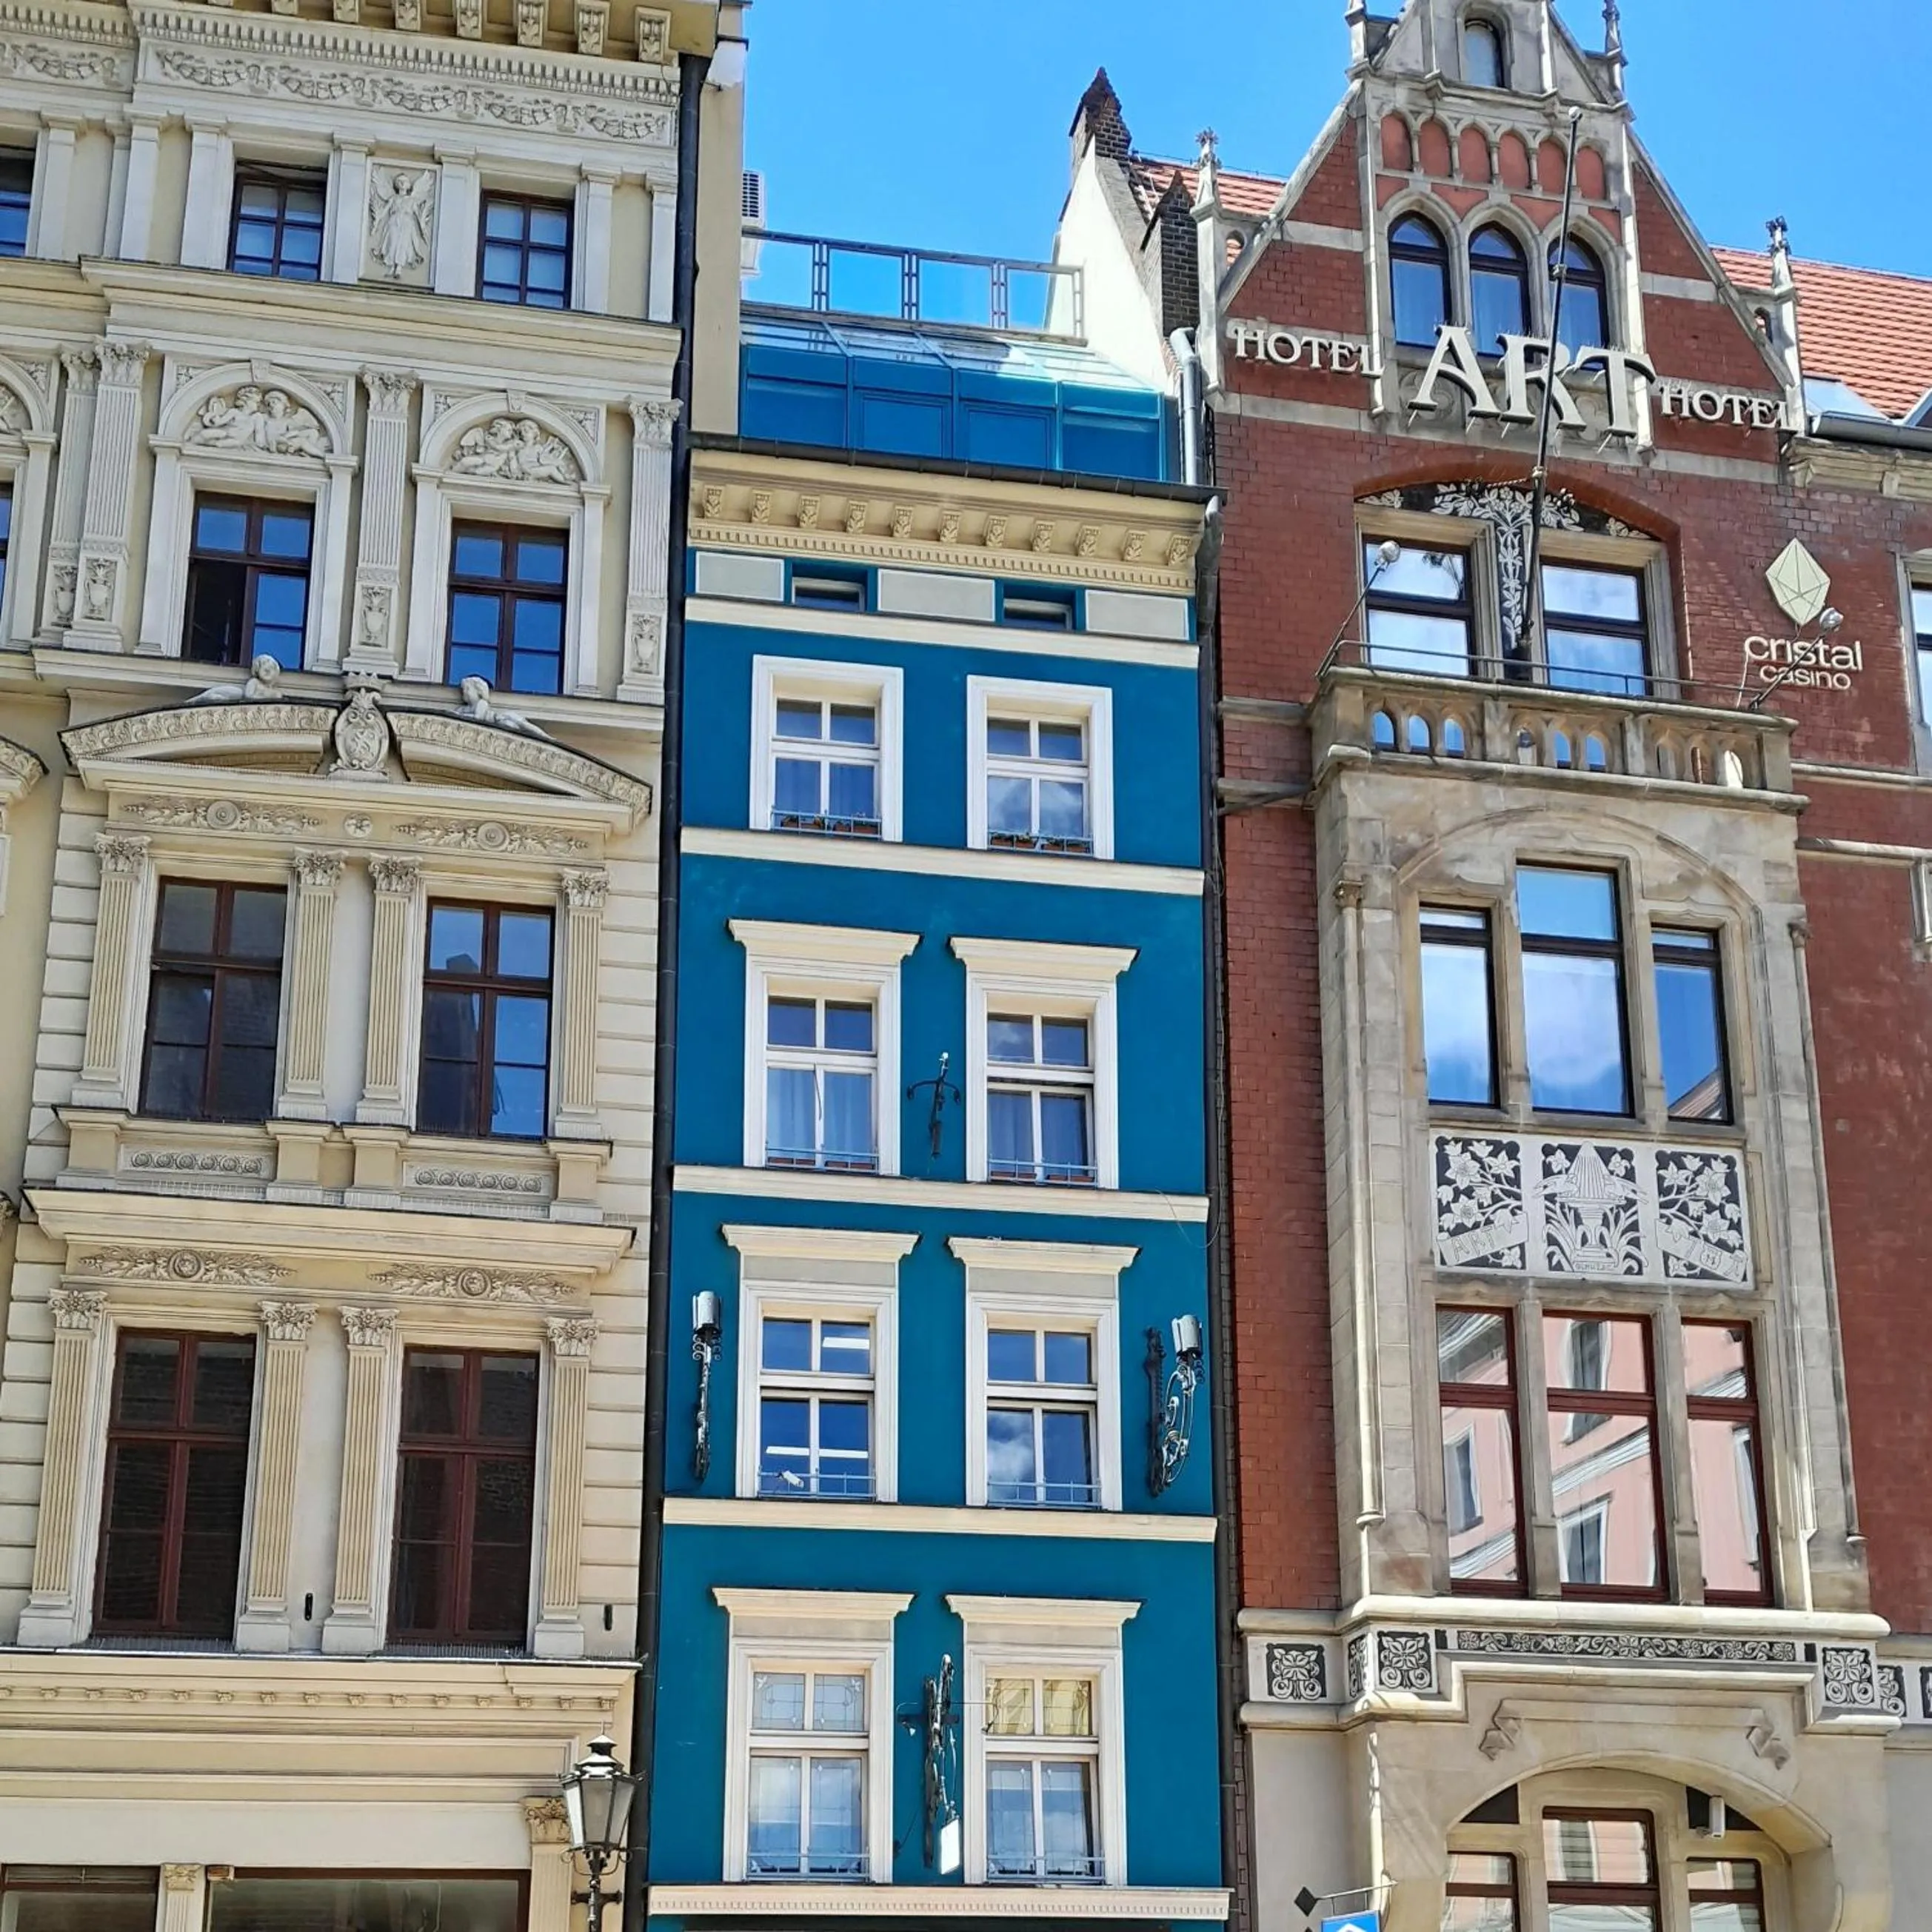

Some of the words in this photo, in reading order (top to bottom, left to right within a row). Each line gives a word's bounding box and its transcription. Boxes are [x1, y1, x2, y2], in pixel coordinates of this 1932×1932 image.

[1234, 326, 1385, 377] HOTEL
[1407, 324, 1657, 438] ART
[1659, 384, 1802, 432] HOTEL
[1759, 665, 1851, 690] casino
